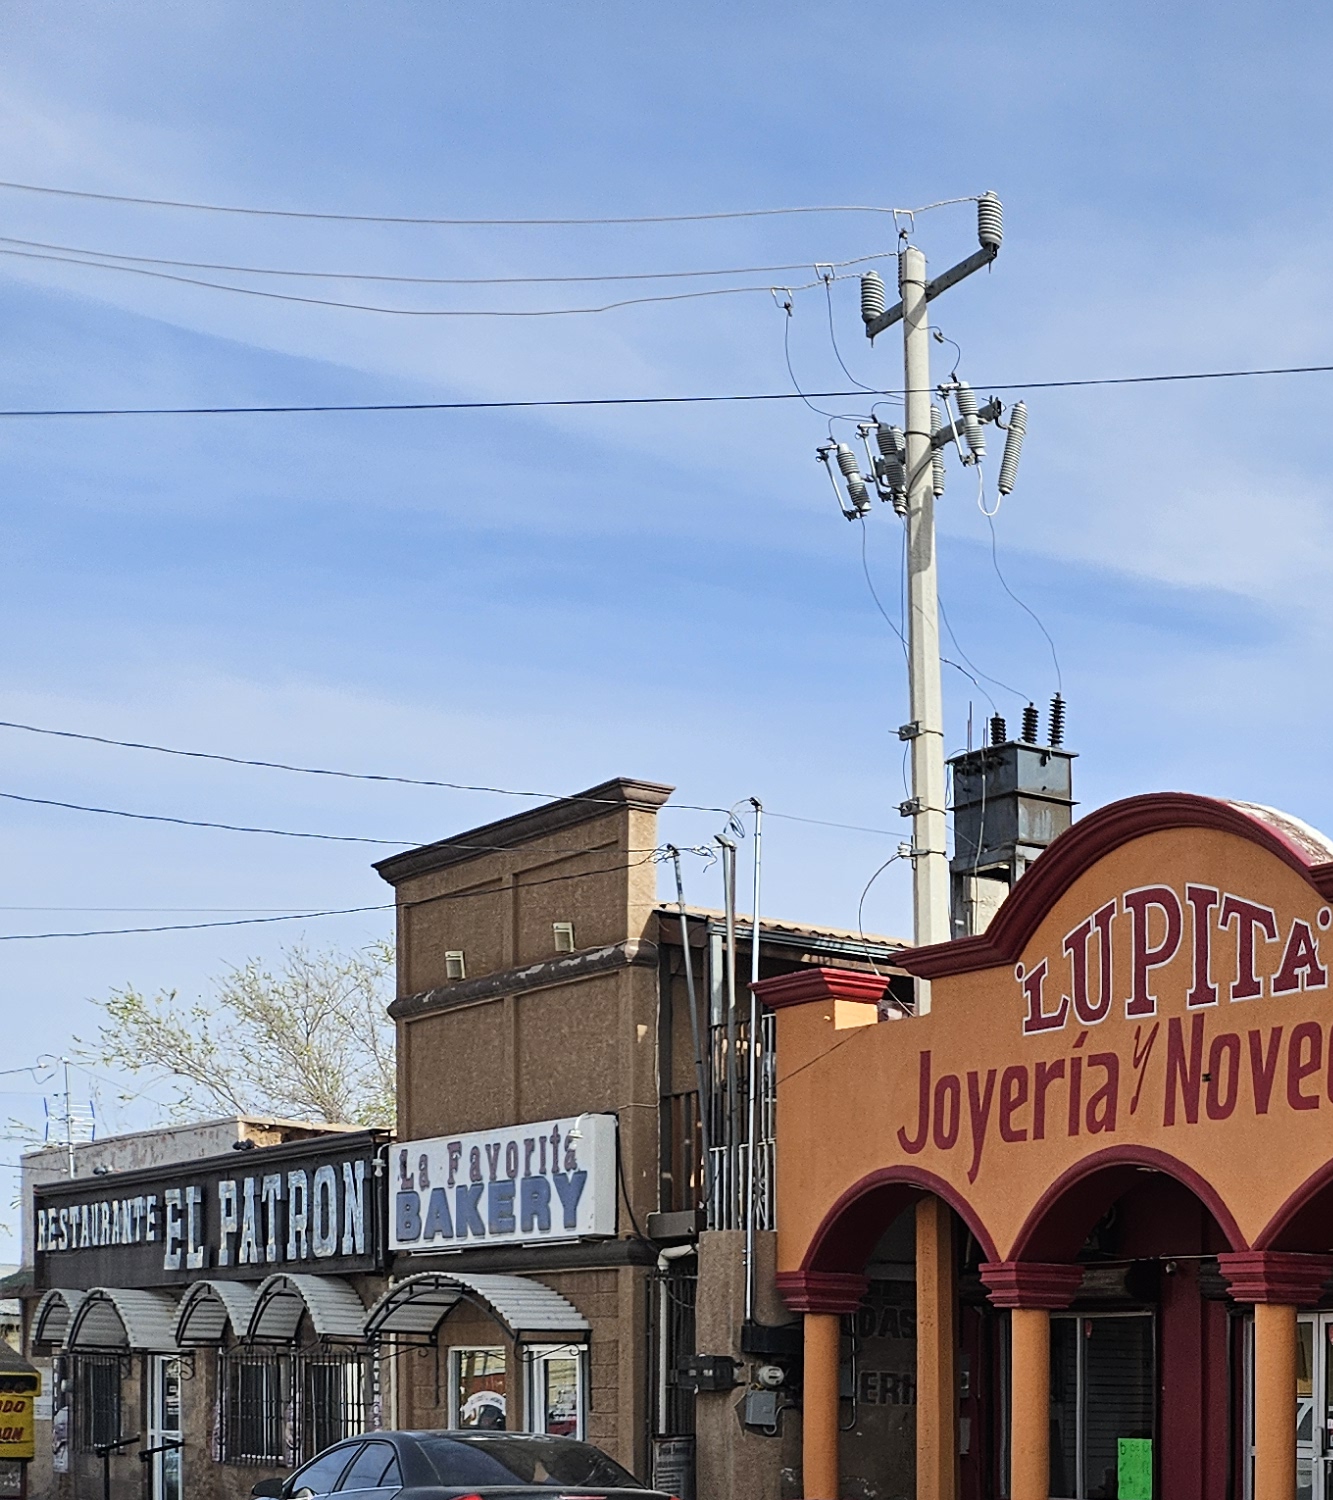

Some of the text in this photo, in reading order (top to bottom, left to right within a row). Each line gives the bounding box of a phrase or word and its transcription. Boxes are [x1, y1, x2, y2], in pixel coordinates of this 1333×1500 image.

[1018, 883, 1331, 1036] LUPITA
[398, 1124, 578, 1188] La Favorita
[897, 1031, 1118, 1184] Joyería
[37, 1160, 367, 1271] RESTAURANTE EL PATRON
[395, 1170, 588, 1242] BAKERY
